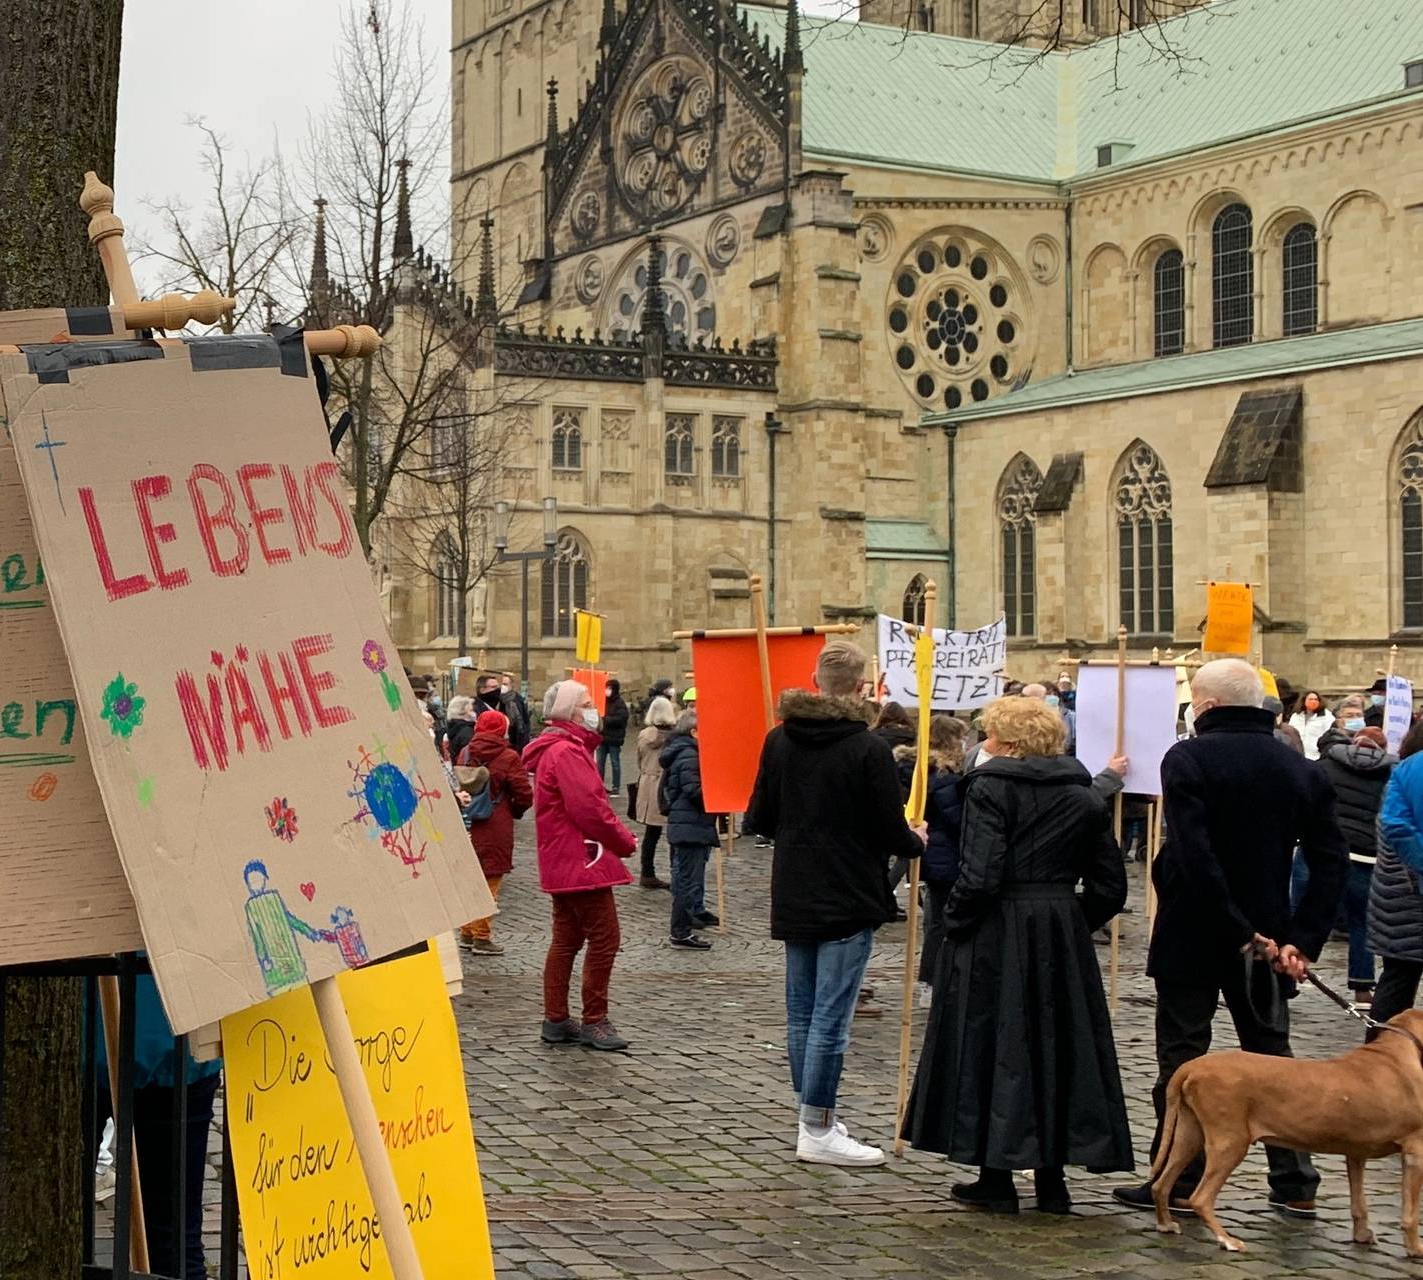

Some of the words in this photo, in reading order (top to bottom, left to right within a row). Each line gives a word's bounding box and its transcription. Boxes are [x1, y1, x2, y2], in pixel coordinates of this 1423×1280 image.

[78, 463, 354, 602] LEBENS
[175, 632, 356, 773] NÄHE
[324, 1010, 424, 1092] rge
[252, 1132, 284, 1218] für
[290, 1125, 339, 1180] den
[346, 1085, 454, 1164] enschen
[294, 1200, 381, 1272] wichtige
[402, 1172, 432, 1226] als
